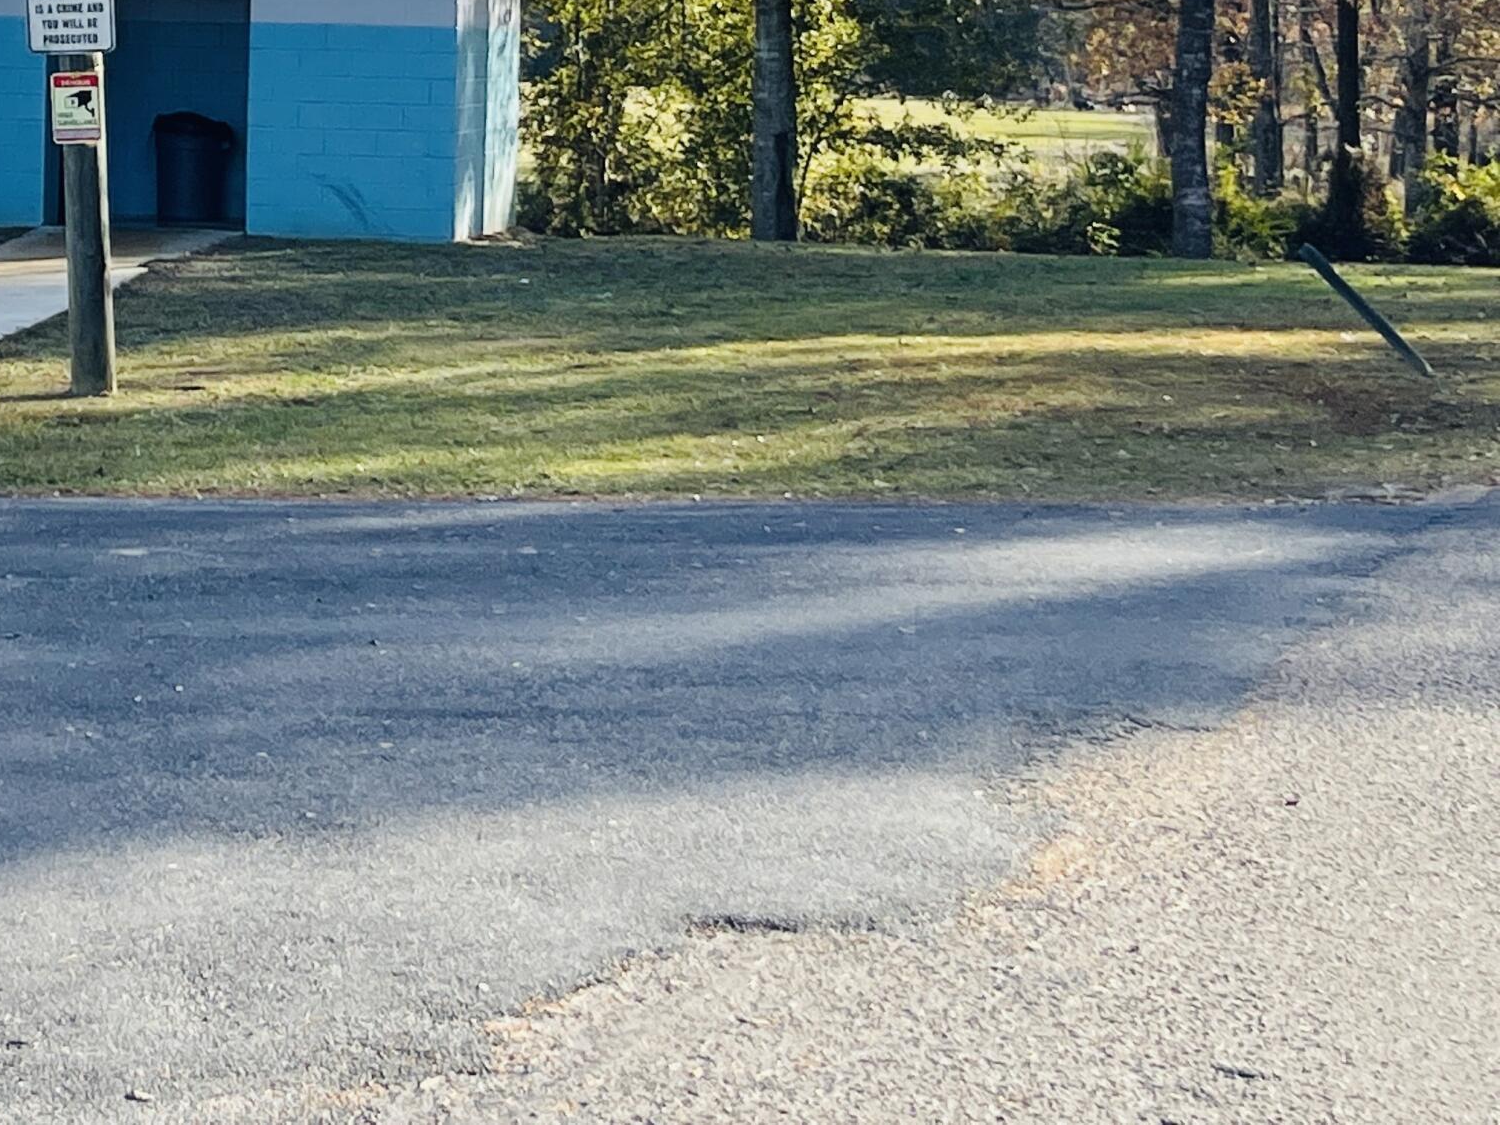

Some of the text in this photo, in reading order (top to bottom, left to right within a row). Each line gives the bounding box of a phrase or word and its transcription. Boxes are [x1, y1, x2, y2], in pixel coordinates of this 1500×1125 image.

[35, 2, 104, 14] IS A CRIME AND
[42, 17, 98, 30] YOU WILL BE
[43, 34, 99, 46] PROSECUTED
